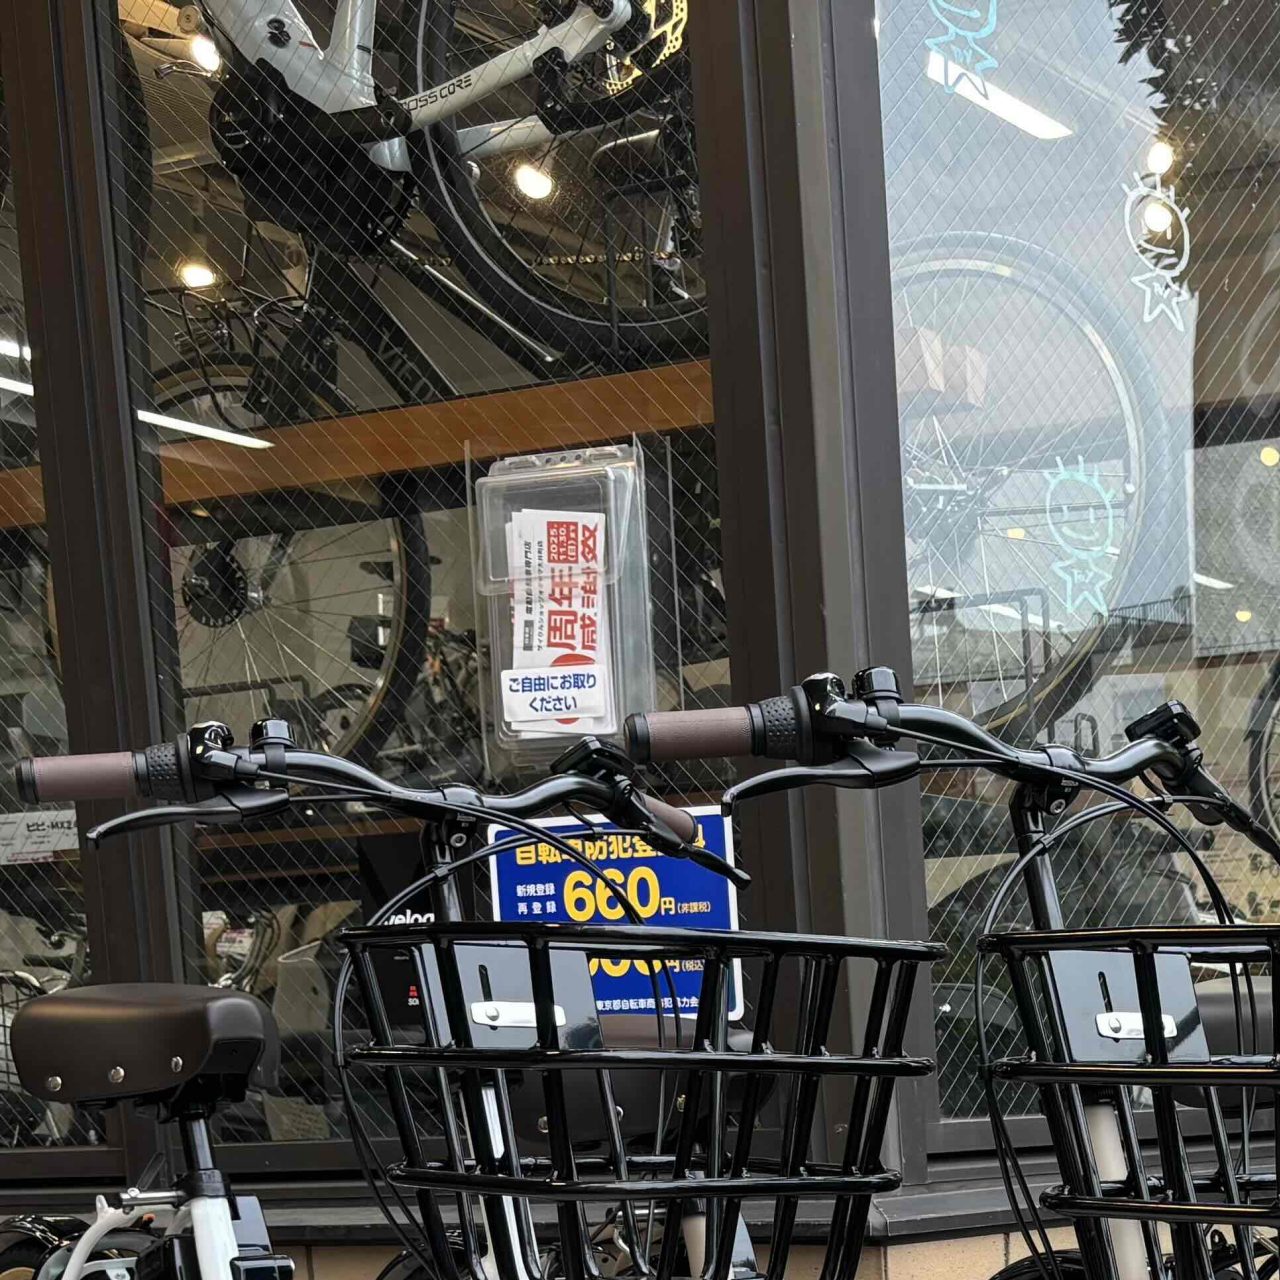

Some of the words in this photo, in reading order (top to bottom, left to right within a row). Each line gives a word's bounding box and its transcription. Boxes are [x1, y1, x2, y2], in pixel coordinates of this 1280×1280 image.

[509, 673, 597, 693] ご自由にお取り
[529, 696, 577, 712] ください
[516, 883, 555, 897] 新規登録
